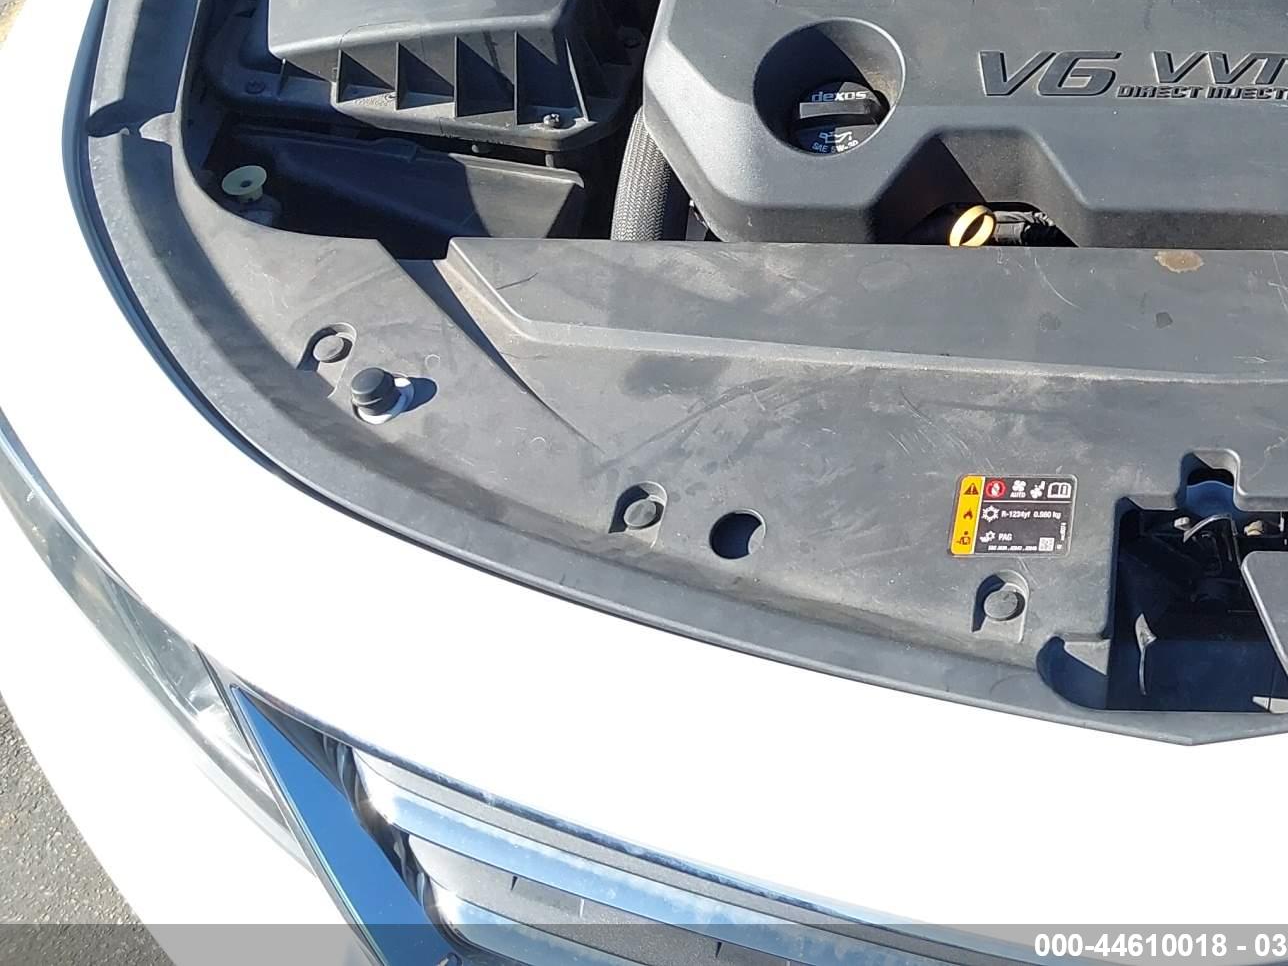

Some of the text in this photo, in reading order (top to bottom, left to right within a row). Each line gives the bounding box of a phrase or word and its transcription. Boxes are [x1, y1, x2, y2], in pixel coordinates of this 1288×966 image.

[978, 50, 1122, 97] V6
[811, 91, 868, 102] dexos
[1117, 85, 1205, 99] DIRECT
[811, 142, 828, 153] SAE
[998, 533, 1013, 541] PAG
